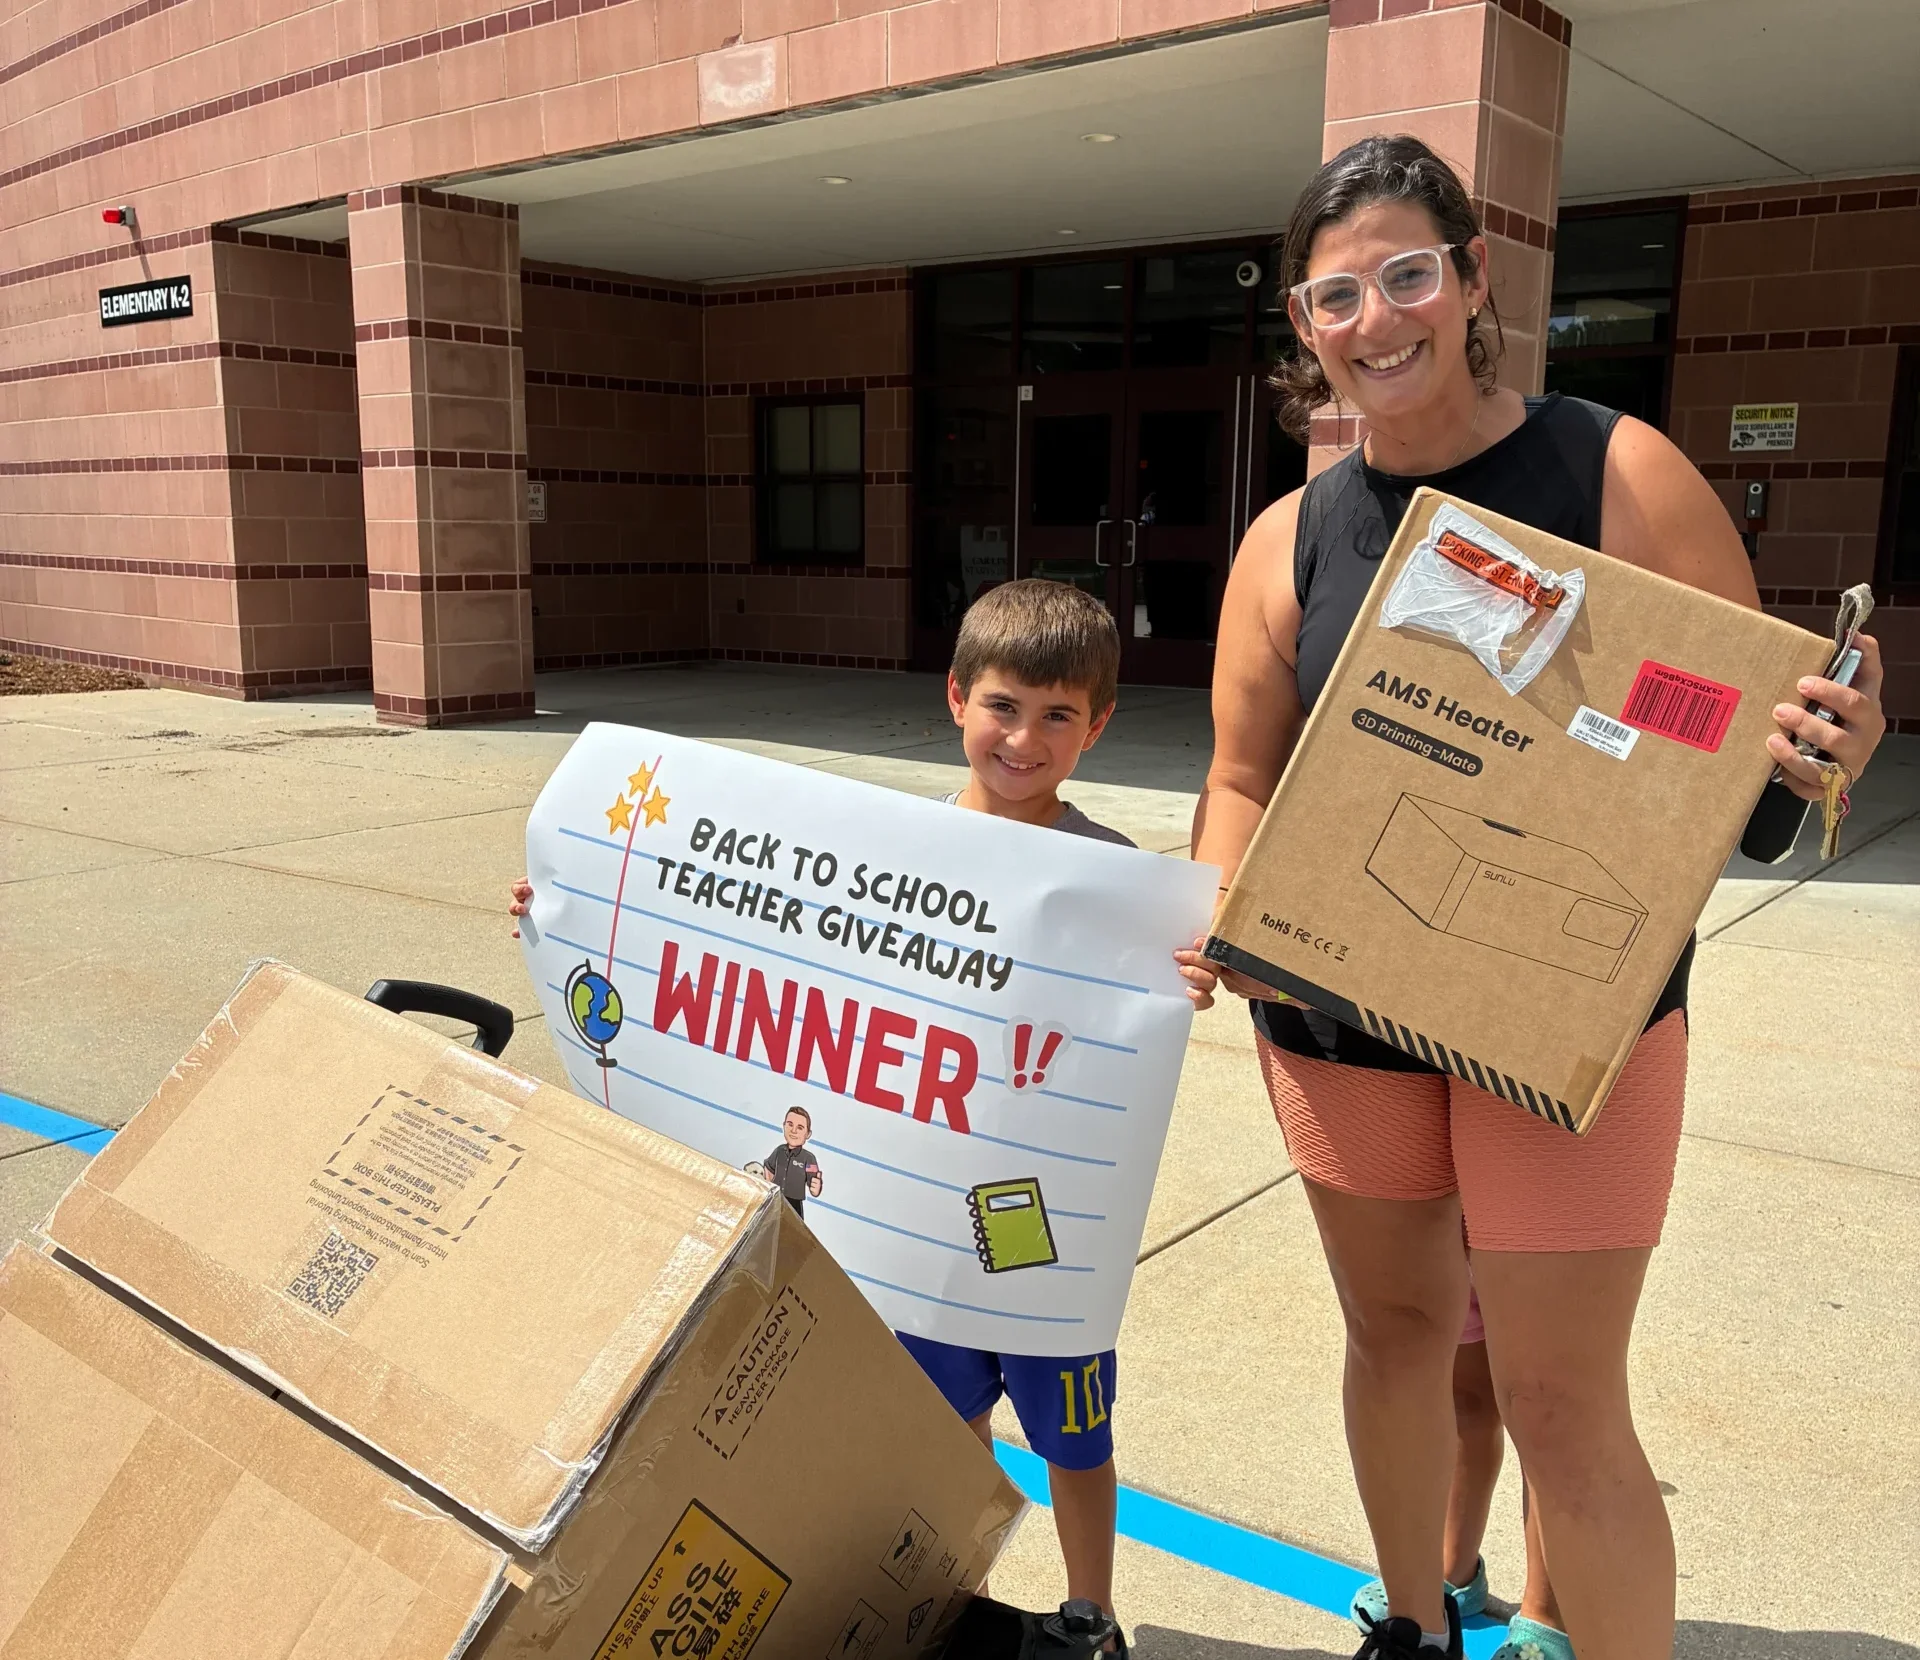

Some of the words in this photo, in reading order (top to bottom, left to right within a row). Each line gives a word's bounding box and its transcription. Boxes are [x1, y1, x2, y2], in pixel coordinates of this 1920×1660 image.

[101, 287, 168, 319] ELEMENTARY
[170, 284, 190, 309] K-2
[1735, 408, 1768, 420] SECURITY
[1769, 407, 1795, 418] NOTICE
[1365, 669, 1432, 710] AMS
[1433, 695, 1535, 753] Heater
[1357, 713, 1377, 729] 3D
[1378, 723, 1477, 773] Printing-Mate
[689, 817, 781, 870] BACK
[791, 846, 838, 887] TO
[847, 863, 998, 933] SCHOOL
[656, 857, 804, 934] TEACHER
[817, 905, 1013, 992] GIVEAWAY
[1260, 912, 1291, 935] RoHS
[1314, 937, 1333, 954] CE
[653, 940, 979, 1134] WINNER
[305, 1196, 333, 1215] tutorial
[371, 1172, 391, 1187] THIS
[389, 1182, 412, 1197] KEEP
[409, 1191, 441, 1212] PLEASE
[310, 1178, 447, 1259] https://bambulab.com/support/unboxing
[332, 1208, 366, 1231] unboxing
[365, 1228, 378, 1240] the
[378, 1235, 401, 1251] watch
[401, 1247, 410, 1257] to
[410, 1252, 429, 1268] Scan
[725, 1305, 789, 1401] CAUTION
[728, 1383, 755, 1425] HEAVY
[755, 1327, 791, 1383] PACKAGE
[745, 1381, 768, 1414] OVER
[767, 1350, 788, 1378] 15Kg
[1060, 1355, 1107, 1434] 10
[624, 1592, 652, 1630] SIDE
[648, 1567, 665, 1590] UP
[650, 1562, 712, 1658] ASS
[671, 1558, 738, 1657] GILE
[691, 1586, 743, 1660] 易碎
[720, 1639, 739, 1660] TH
[738, 1587, 771, 1637] CARE
